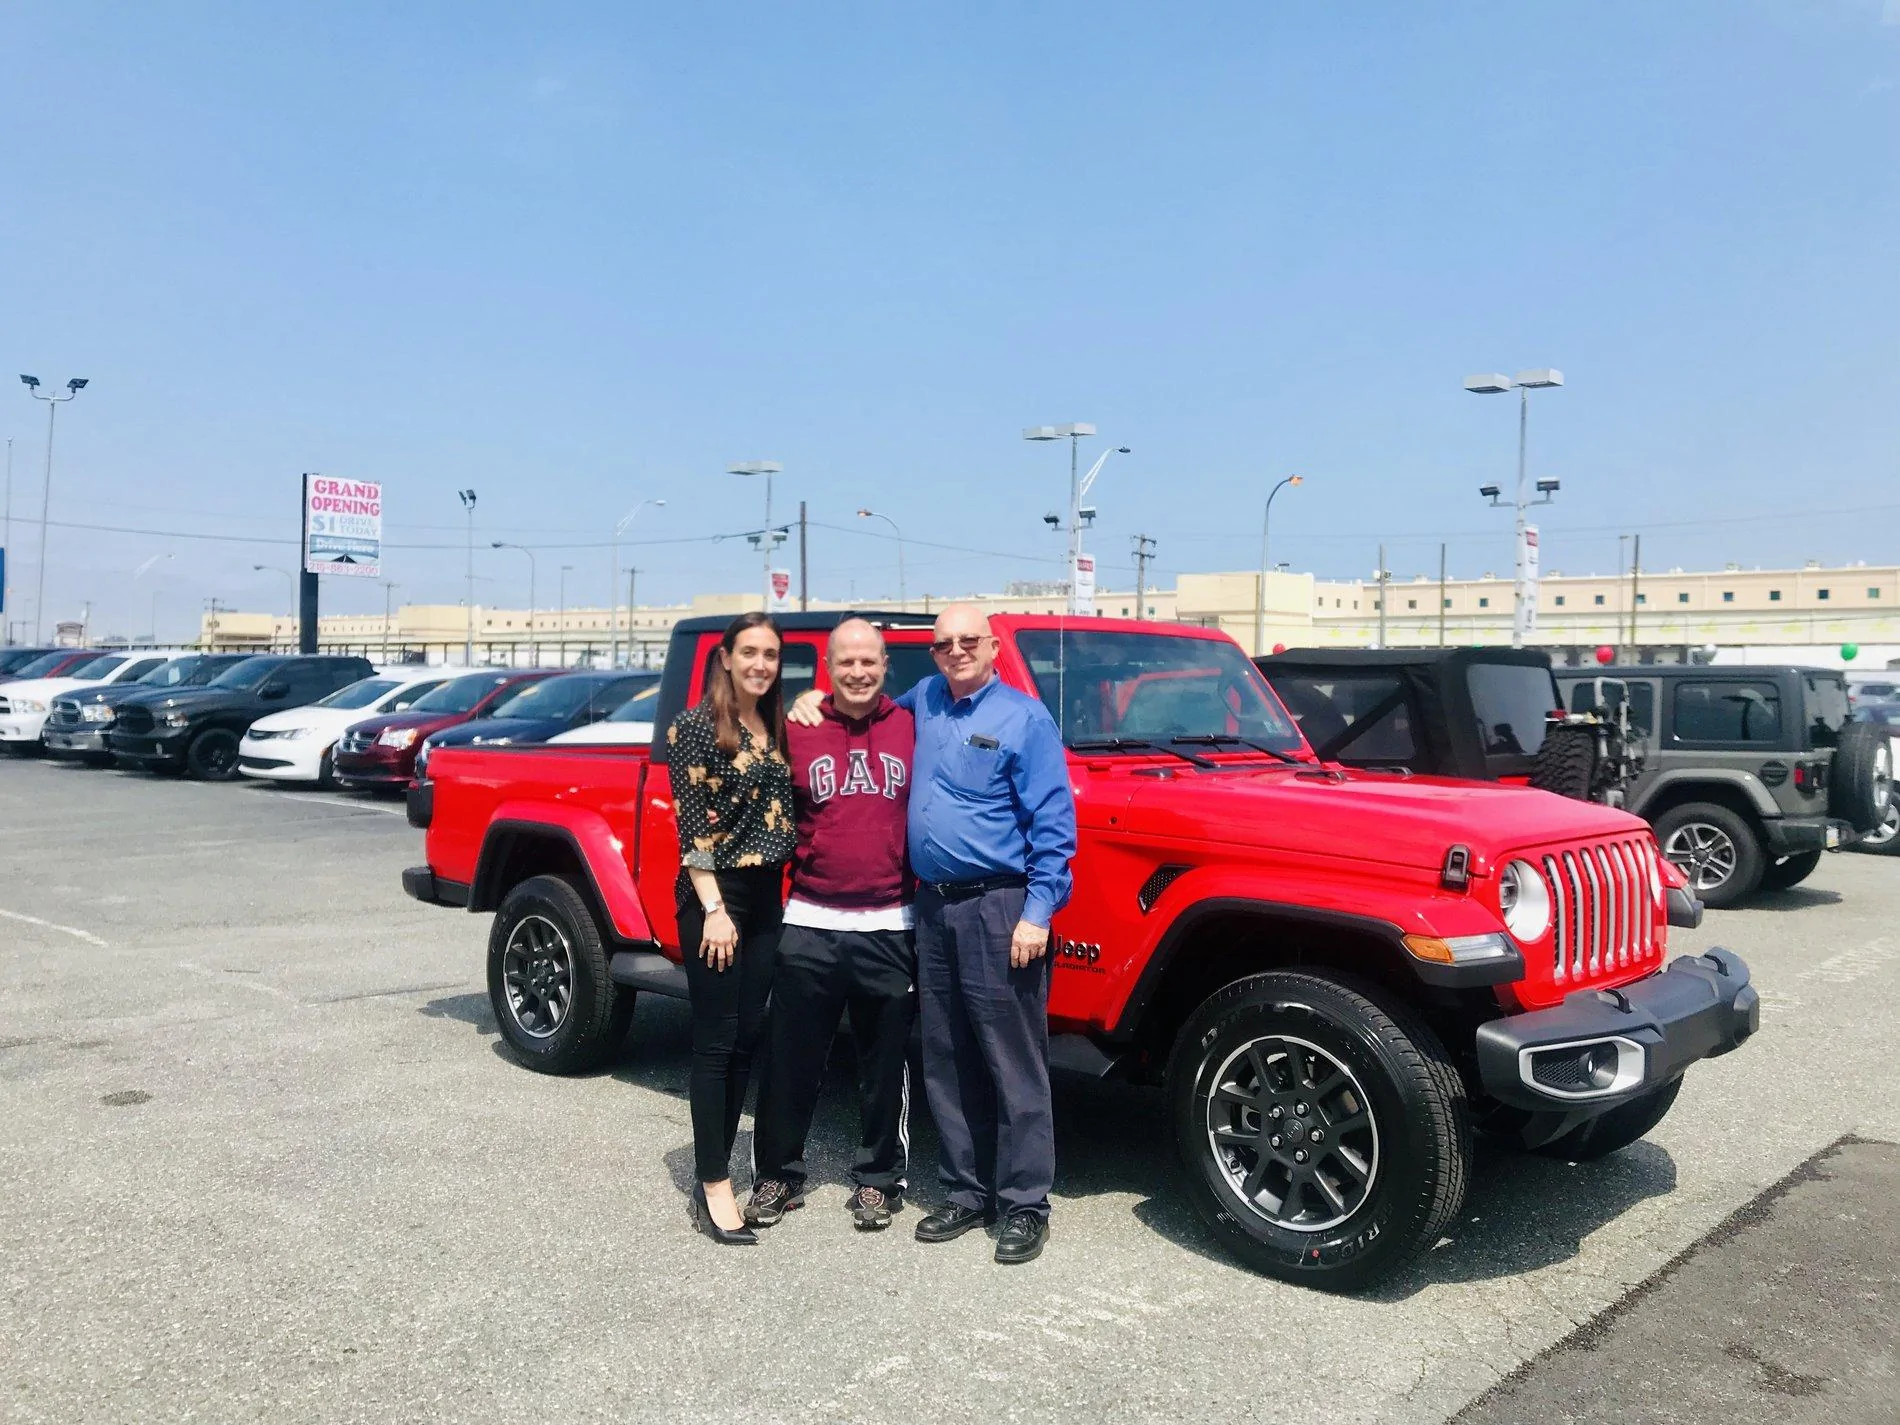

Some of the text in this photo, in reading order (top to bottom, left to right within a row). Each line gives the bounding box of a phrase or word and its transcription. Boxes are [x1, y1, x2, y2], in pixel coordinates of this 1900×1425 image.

[314, 479, 378, 499] GRAND
[311, 496, 380, 516] OPENING
[340, 526, 378, 537] TODAY
[808, 749, 906, 804] GAP
[1056, 934, 1101, 966] Jeep
